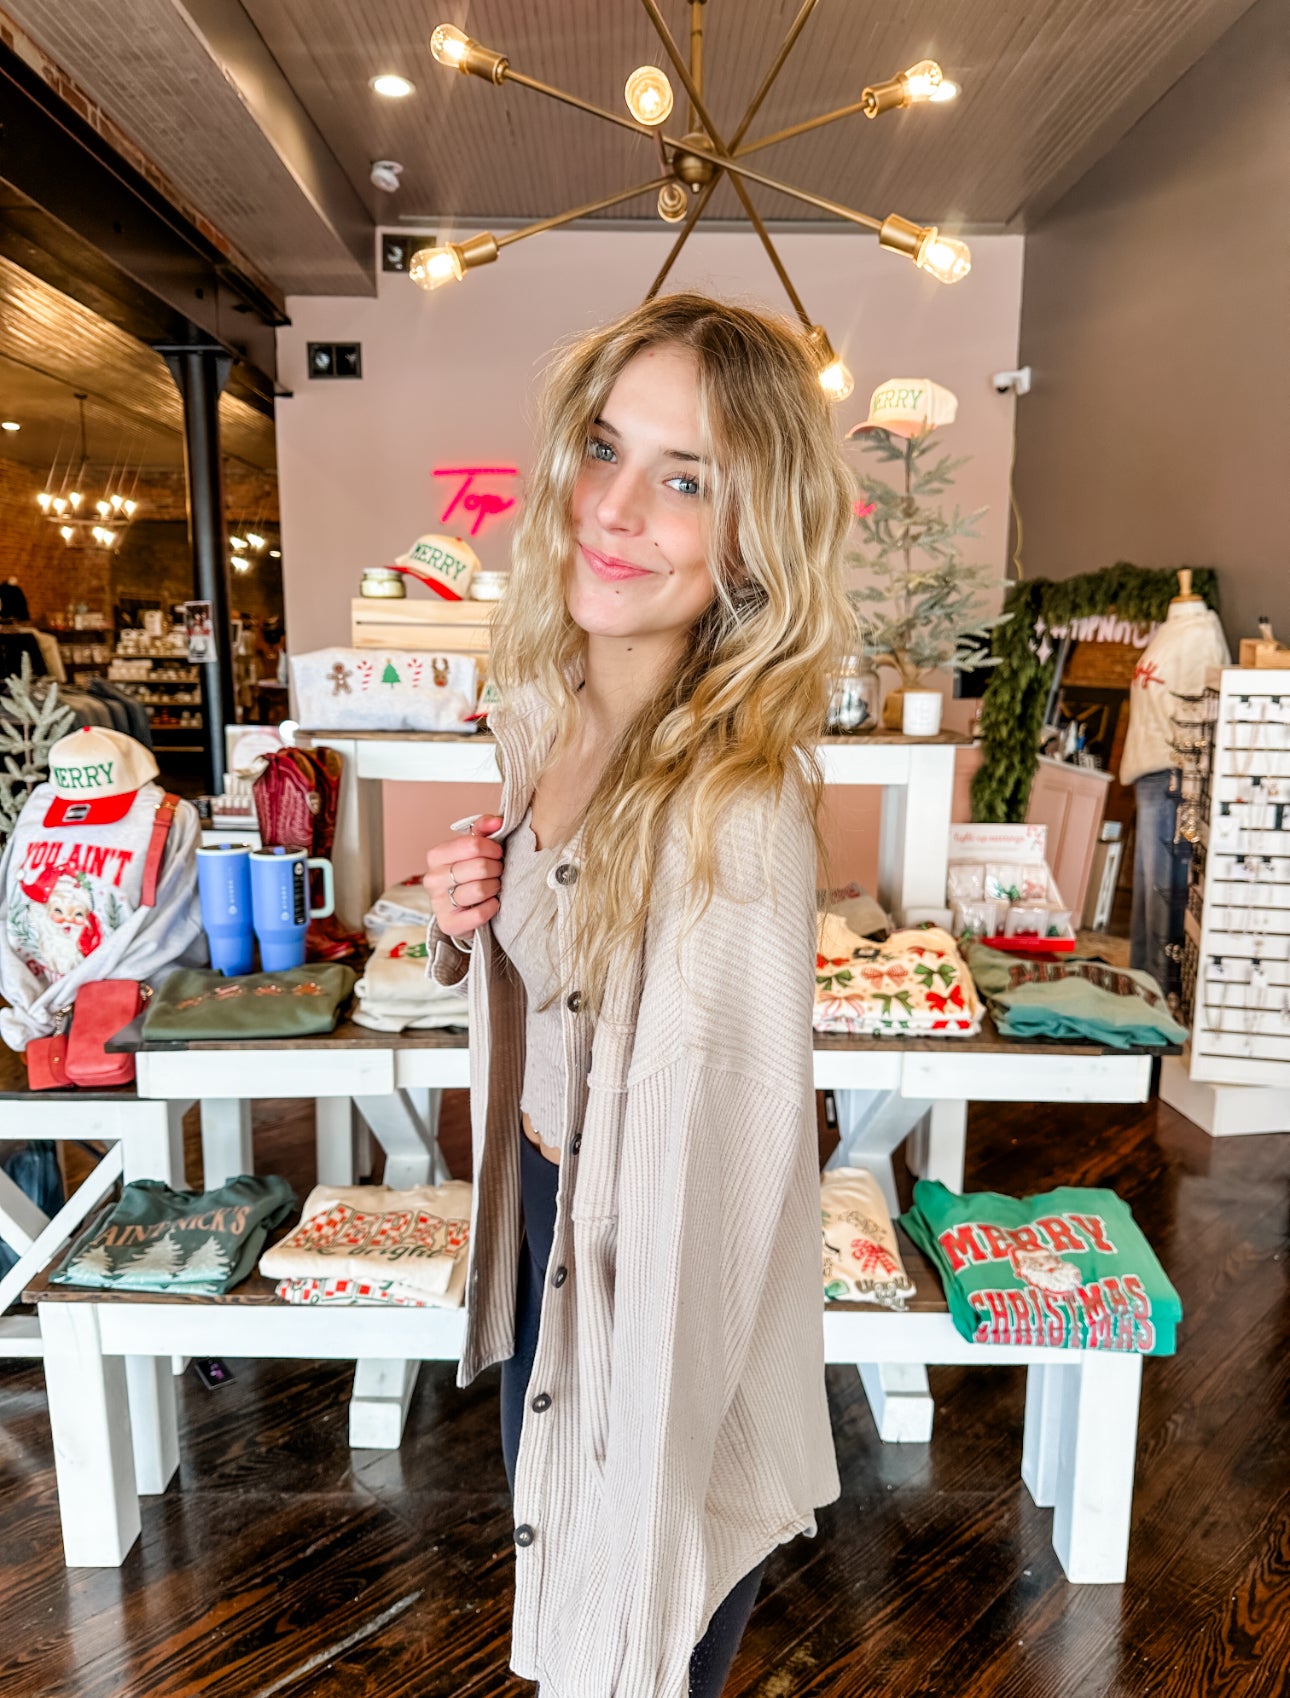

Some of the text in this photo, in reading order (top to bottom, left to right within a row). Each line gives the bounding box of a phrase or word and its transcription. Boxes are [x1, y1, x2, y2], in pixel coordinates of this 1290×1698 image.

[433, 467, 517, 536] Top
[67, 843, 134, 887] AIN'T
[90, 1206, 251, 1246] AINT NICK'S
[938, 1213, 1118, 1275] MERRY
